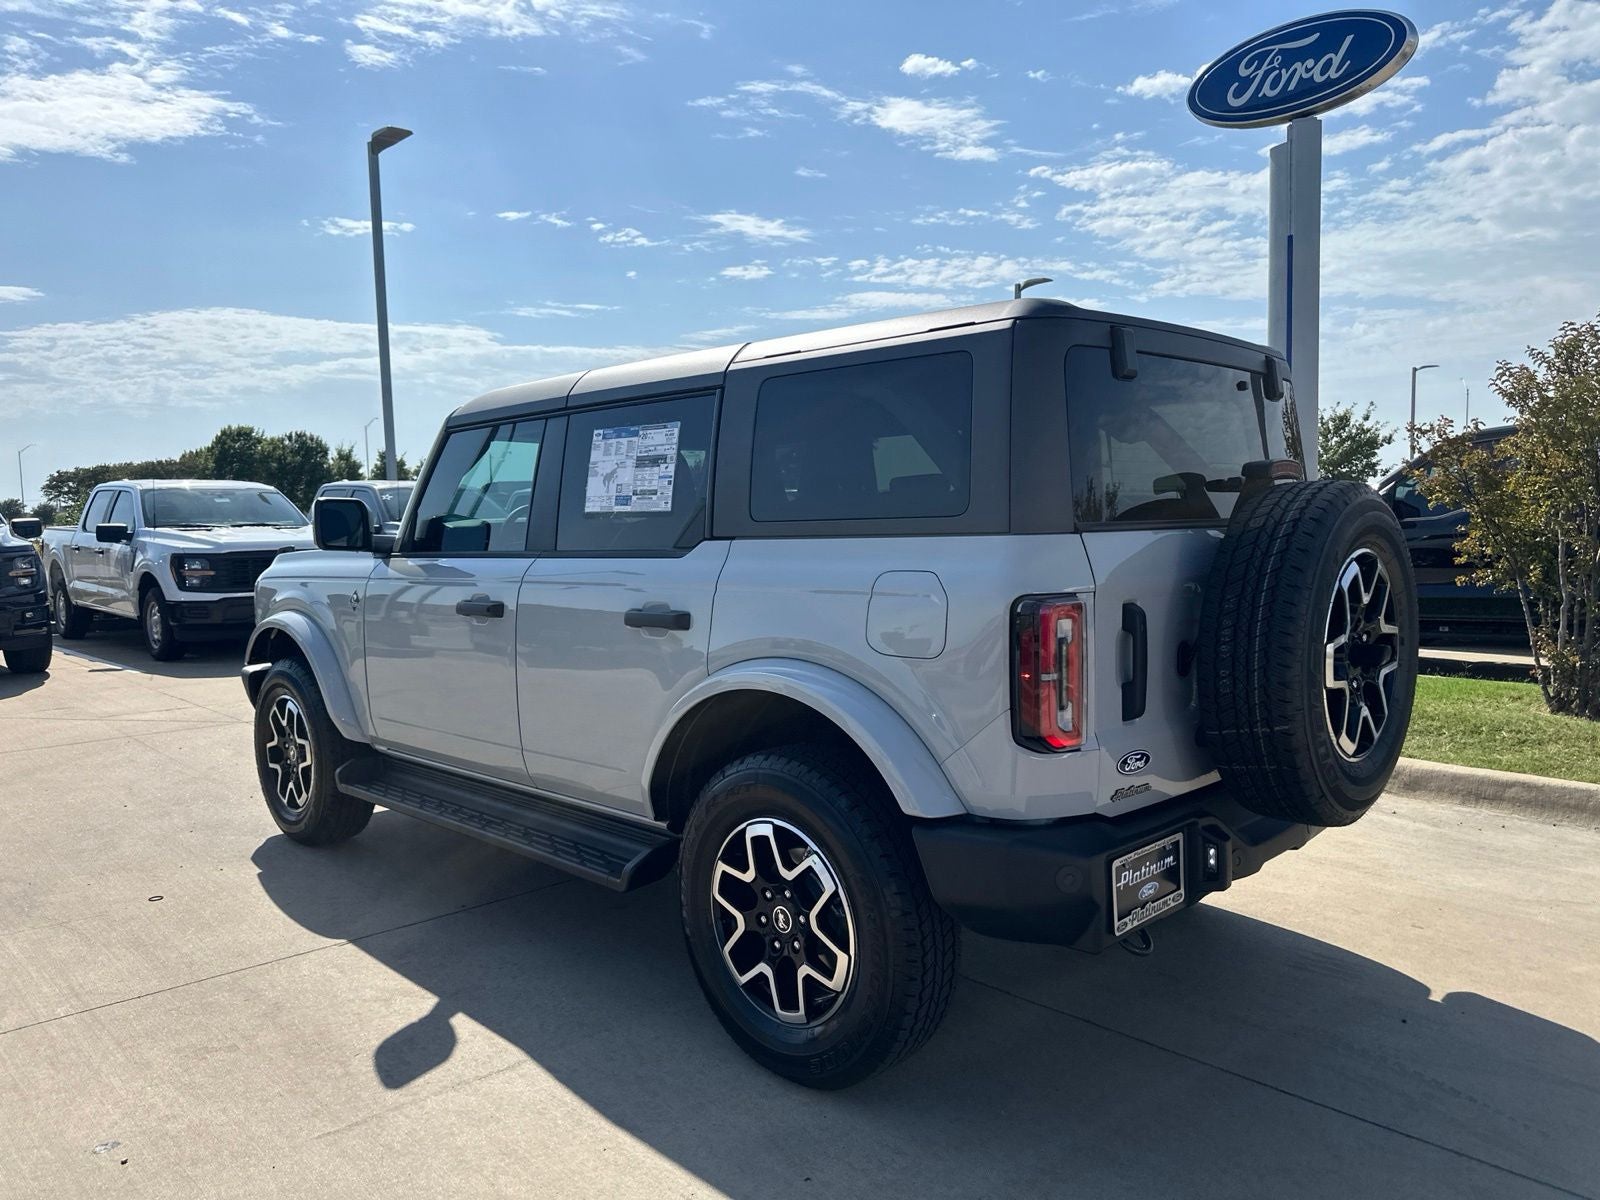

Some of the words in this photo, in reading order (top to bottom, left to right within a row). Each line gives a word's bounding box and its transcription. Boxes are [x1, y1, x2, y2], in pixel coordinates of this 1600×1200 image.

[1227, 31, 1355, 107] Ford
[1125, 754, 1147, 771] Ford
[1116, 855, 1177, 890] Platinum
[1128, 900, 1171, 926] Platinum
